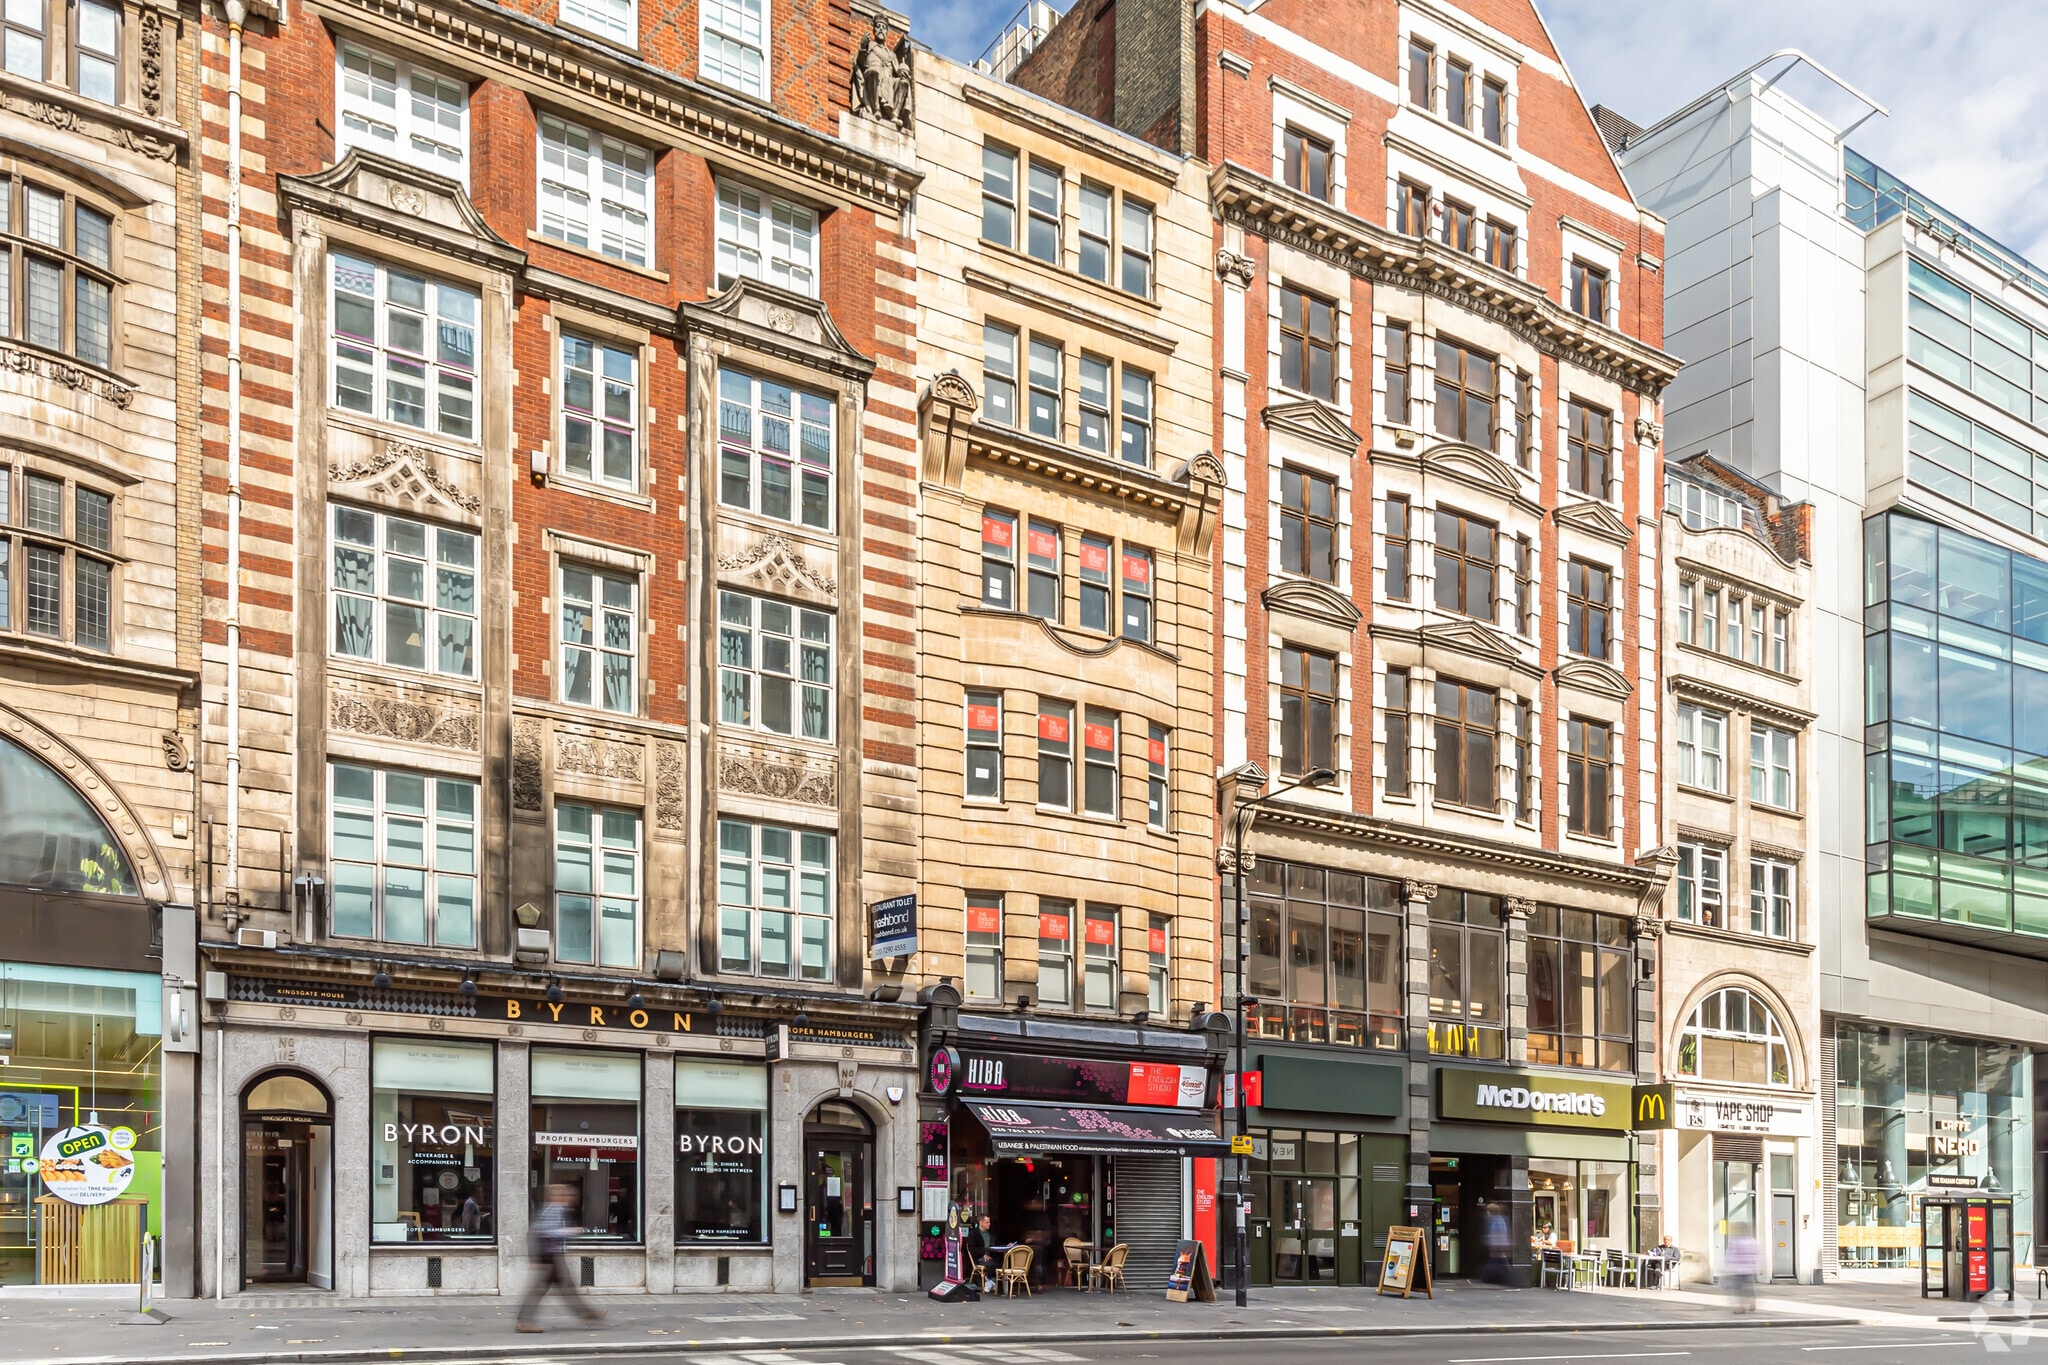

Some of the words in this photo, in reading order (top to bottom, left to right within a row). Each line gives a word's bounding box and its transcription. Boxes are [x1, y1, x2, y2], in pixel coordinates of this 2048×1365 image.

[897, 899, 904, 907] TO
[904, 897, 914, 906] LET
[874, 910, 909, 929] nashbond
[874, 927, 908, 939] nashbond.co.uk
[883, 946, 894, 954] 7290
[894, 944, 907, 952] 4555
[277, 989, 318, 997] KINGSGATE
[507, 1000, 691, 1032] BYRON
[788, 1027, 815, 1035] ROPER
[818, 1030, 874, 1040] HAMBURGERS
[968, 1056, 1003, 1086] HIBA
[1150, 1067, 1163, 1075] THE
[841, 1080, 854, 1089] 114
[1148, 1075, 1177, 1084] ENGLISH
[1148, 1083, 1172, 1092] STUDIO
[1477, 1084, 1606, 1117] McDonald's
[979, 1106, 1024, 1123] HIBA
[1716, 1101, 1742, 1121] VAPE
[1746, 1104, 1774, 1123] SHOP
[384, 1124, 485, 1146] BYRON
[578, 1137, 633, 1145] HAMBURGERS
[62, 1135, 101, 1155] OPEN
[680, 1135, 764, 1155] BYRON
[999, 1142, 1025, 1150] LEBANESE
[1030, 1143, 1062, 1151] PALESTINIAN
[1934, 1137, 1980, 1156] NERO
[928, 1155, 944, 1166] HIBA
